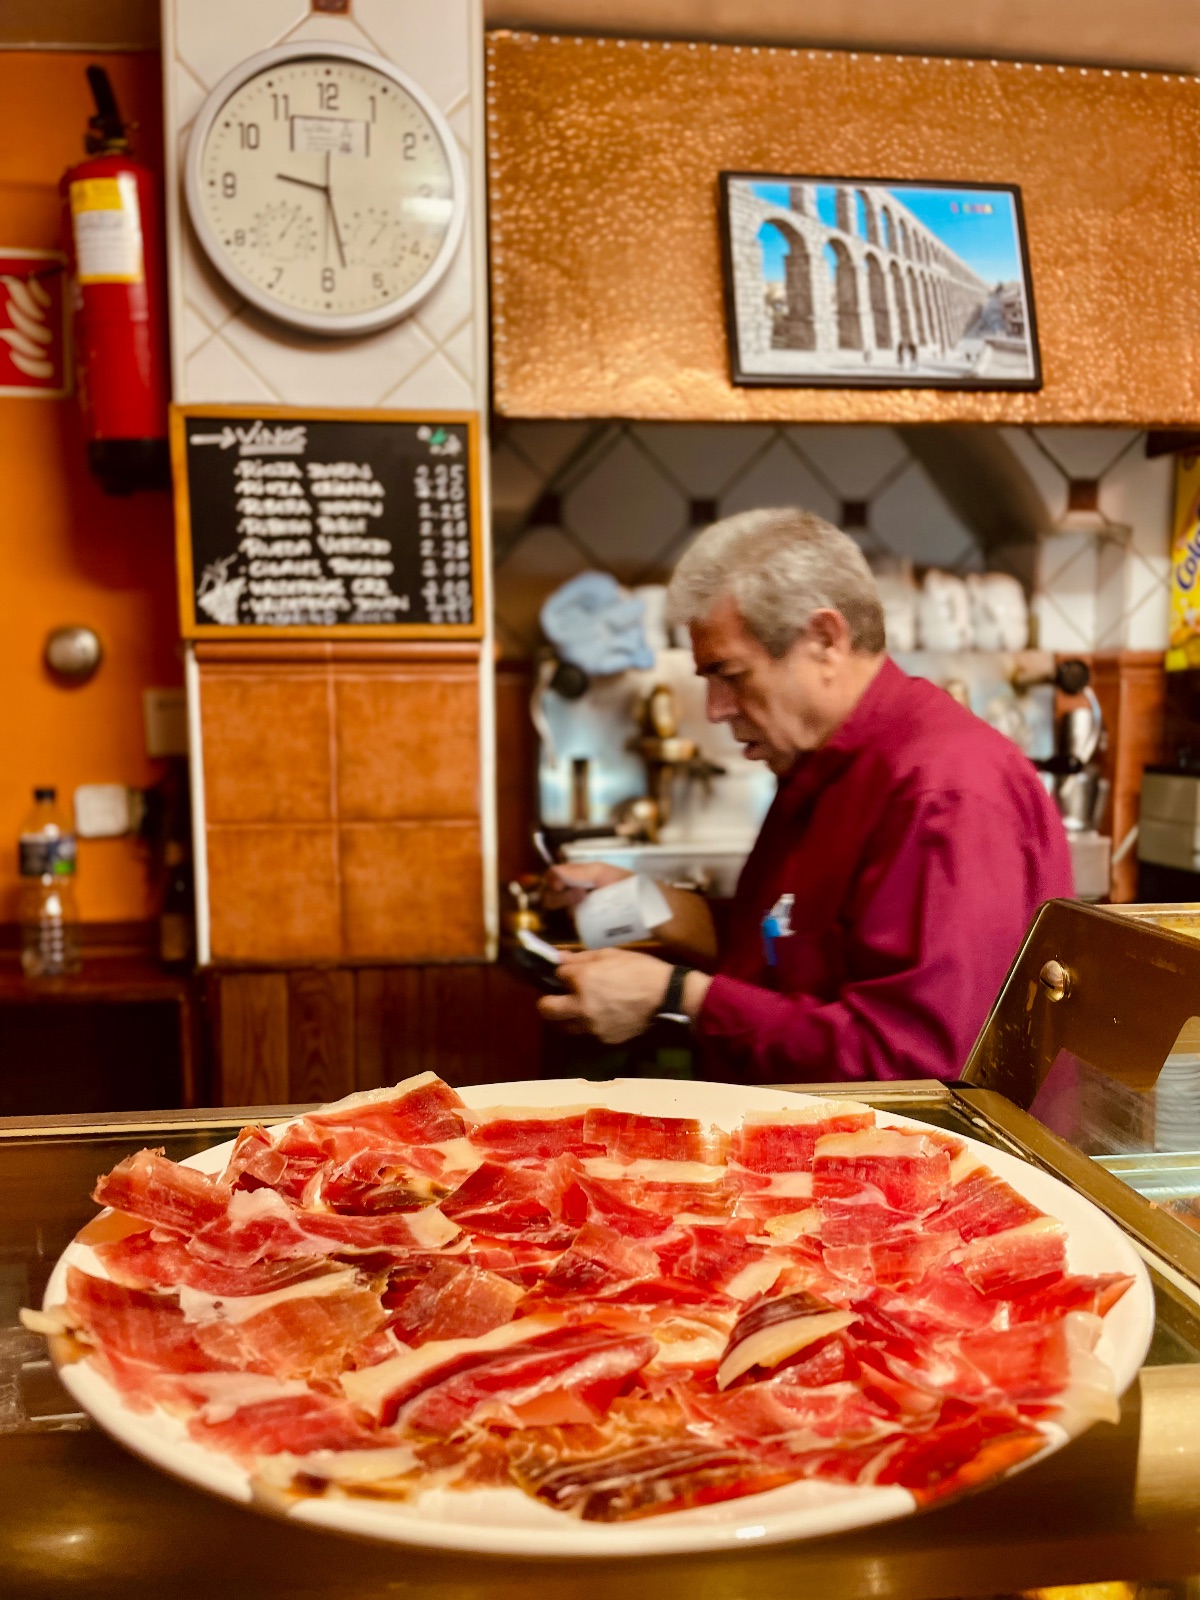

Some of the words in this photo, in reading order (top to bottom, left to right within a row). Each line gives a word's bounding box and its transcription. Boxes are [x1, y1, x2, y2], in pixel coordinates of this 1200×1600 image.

[271, 93, 289, 121] 11
[317, 82, 339, 110] 12
[369, 95, 376, 123] 1
[238, 122, 260, 150] 10
[402, 132, 416, 160] 2
[273, 267, 284, 284] 7
[321, 267, 335, 293] 6
[372, 272, 383, 289] 5
